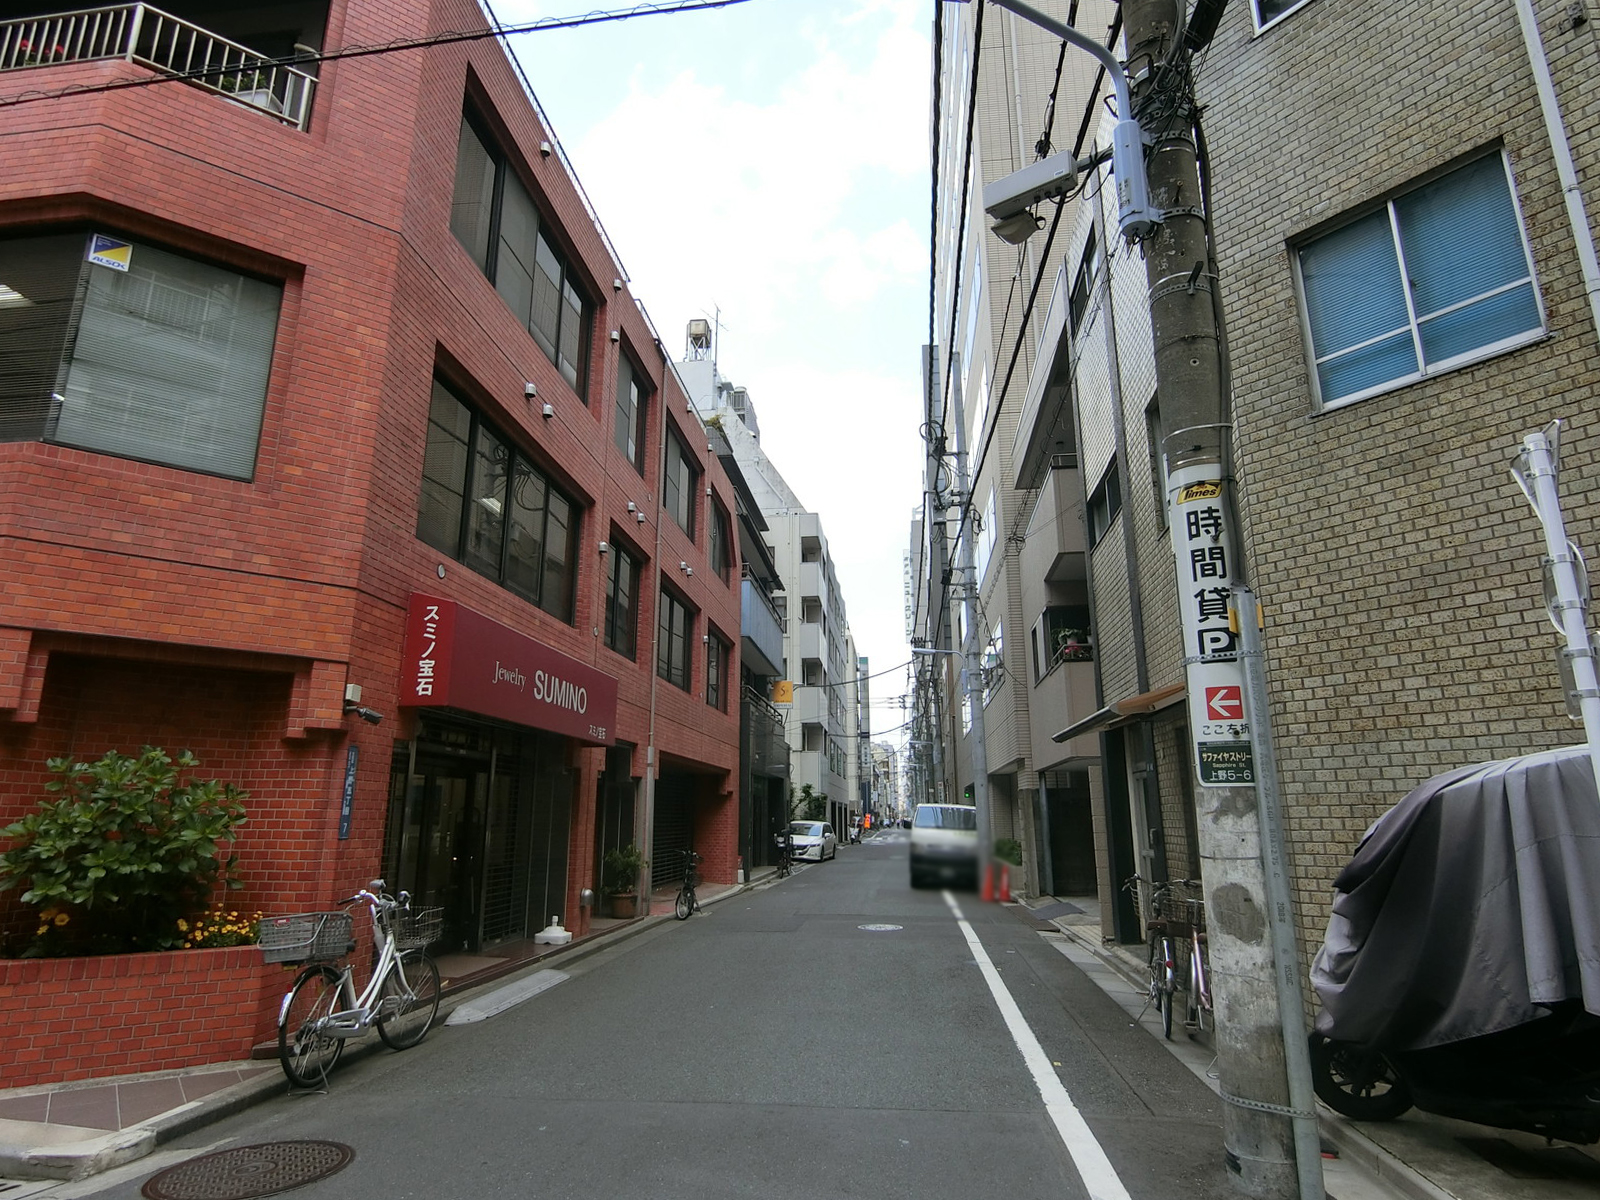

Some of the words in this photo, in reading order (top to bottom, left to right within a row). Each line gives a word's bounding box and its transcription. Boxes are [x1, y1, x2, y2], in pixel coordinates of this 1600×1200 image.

[92, 256, 126, 270] ALSOK
[1184, 489, 1217, 500] Times
[415, 605, 439, 696] スミノ宝石
[492, 660, 527, 692] Jewelry
[533, 669, 588, 715] SUMINO
[1202, 723, 1250, 736] ここ左折
